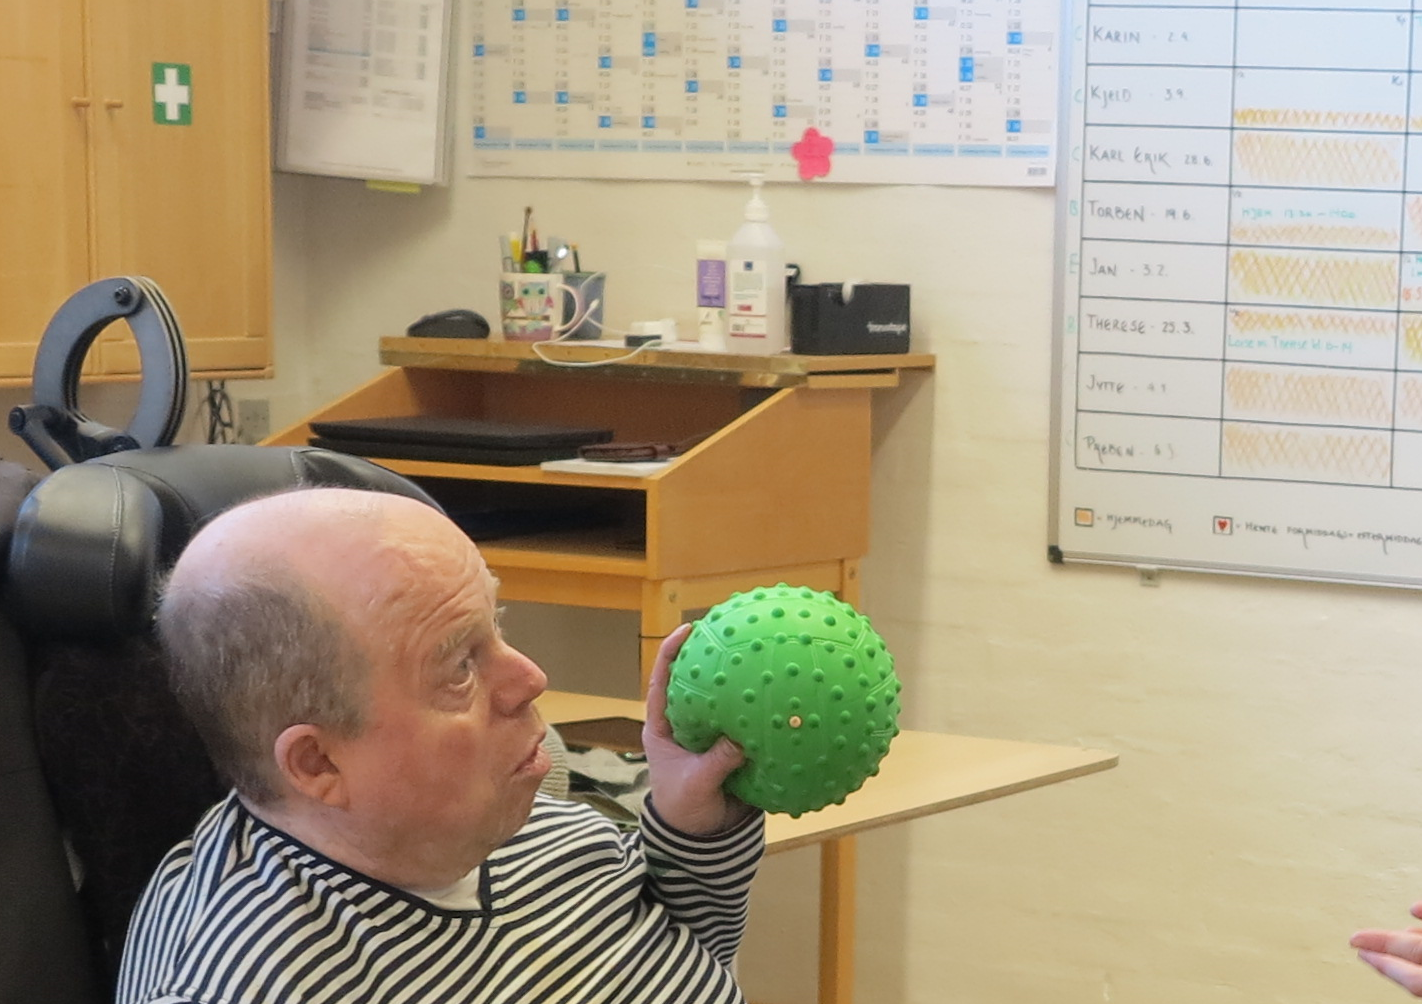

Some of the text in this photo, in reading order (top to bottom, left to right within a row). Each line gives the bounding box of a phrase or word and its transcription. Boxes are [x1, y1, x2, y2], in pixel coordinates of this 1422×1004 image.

[1093, 26, 1141, 43] KARIN
[1089, 146, 1125, 162] KARL
[1088, 200, 1145, 222] TORBEN
[1089, 257, 1117, 276] JAN
[1086, 313, 1146, 335] THERESE
